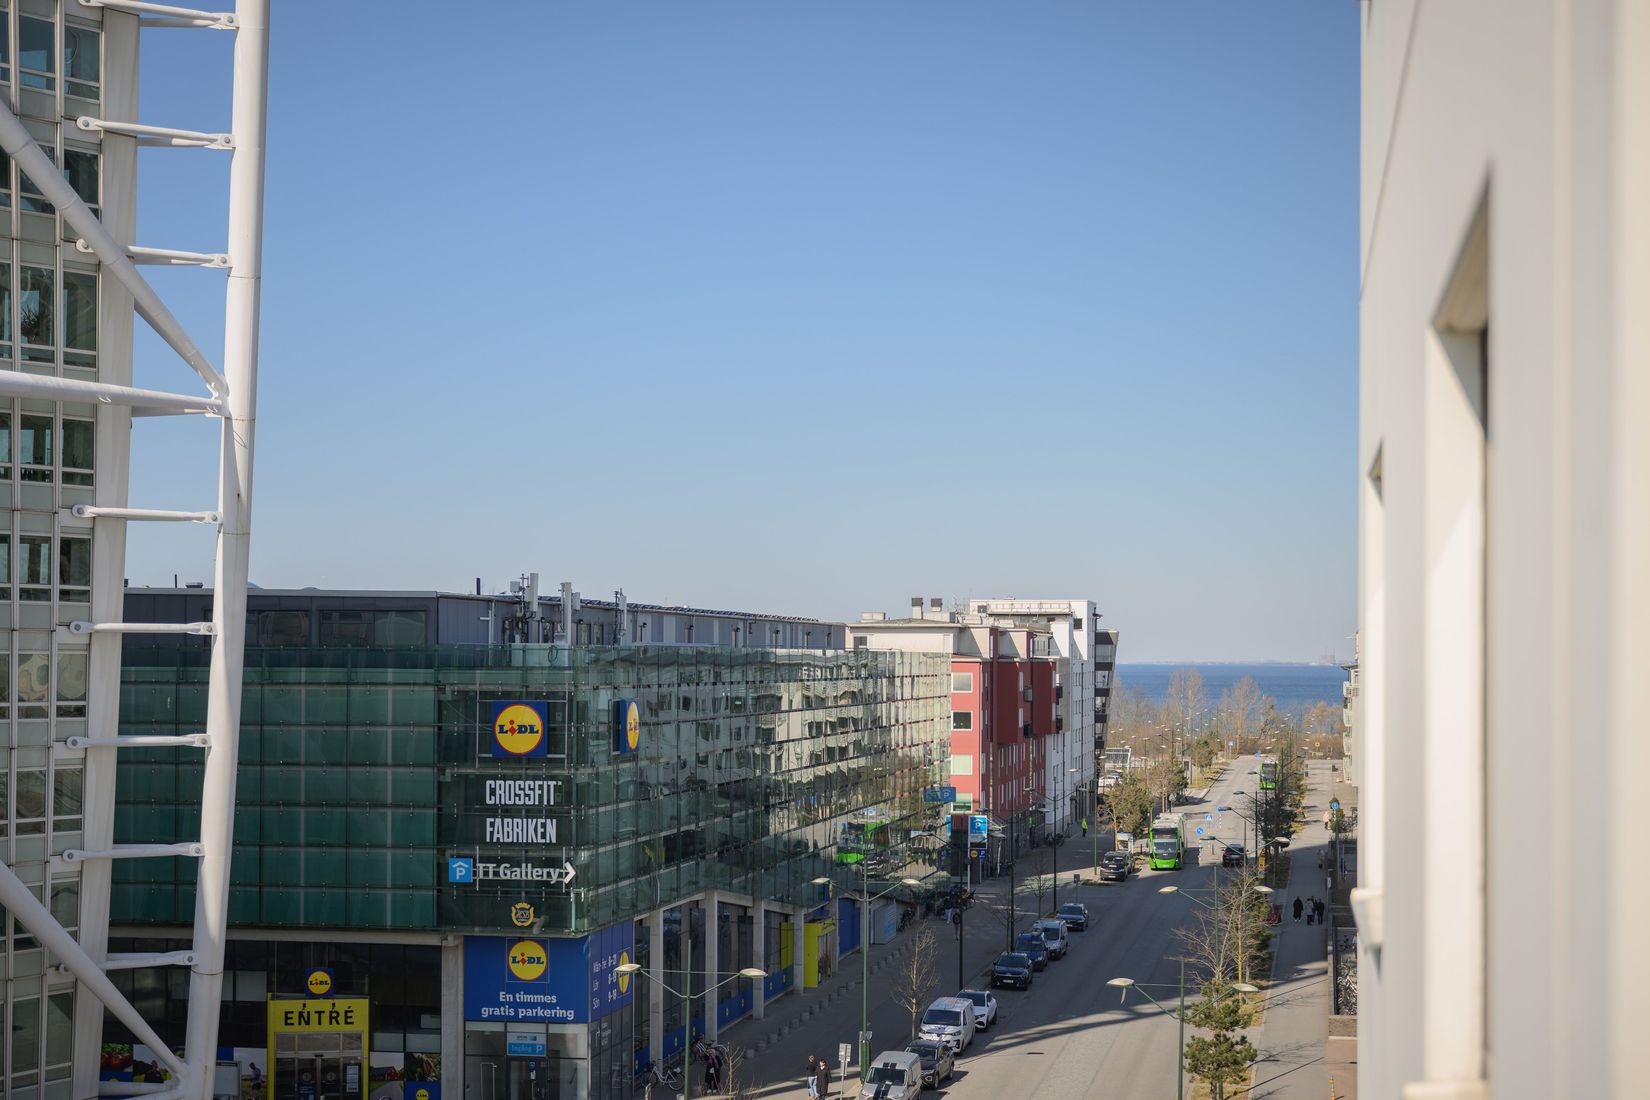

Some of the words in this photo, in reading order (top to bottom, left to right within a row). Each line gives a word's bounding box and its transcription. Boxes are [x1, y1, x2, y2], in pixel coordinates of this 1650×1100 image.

[486, 780, 556, 805] CROSSFIT
[486, 818, 557, 844] FABRIKEN
[478, 863, 496, 881] TT
[499, 863, 560, 885] Gallery
[499, 991, 514, 1002] En
[516, 991, 557, 1003] timmes
[284, 1006, 355, 1026] ENTRÉ
[481, 1005, 515, 1019] gratis
[518, 1005, 575, 1020] parkering
